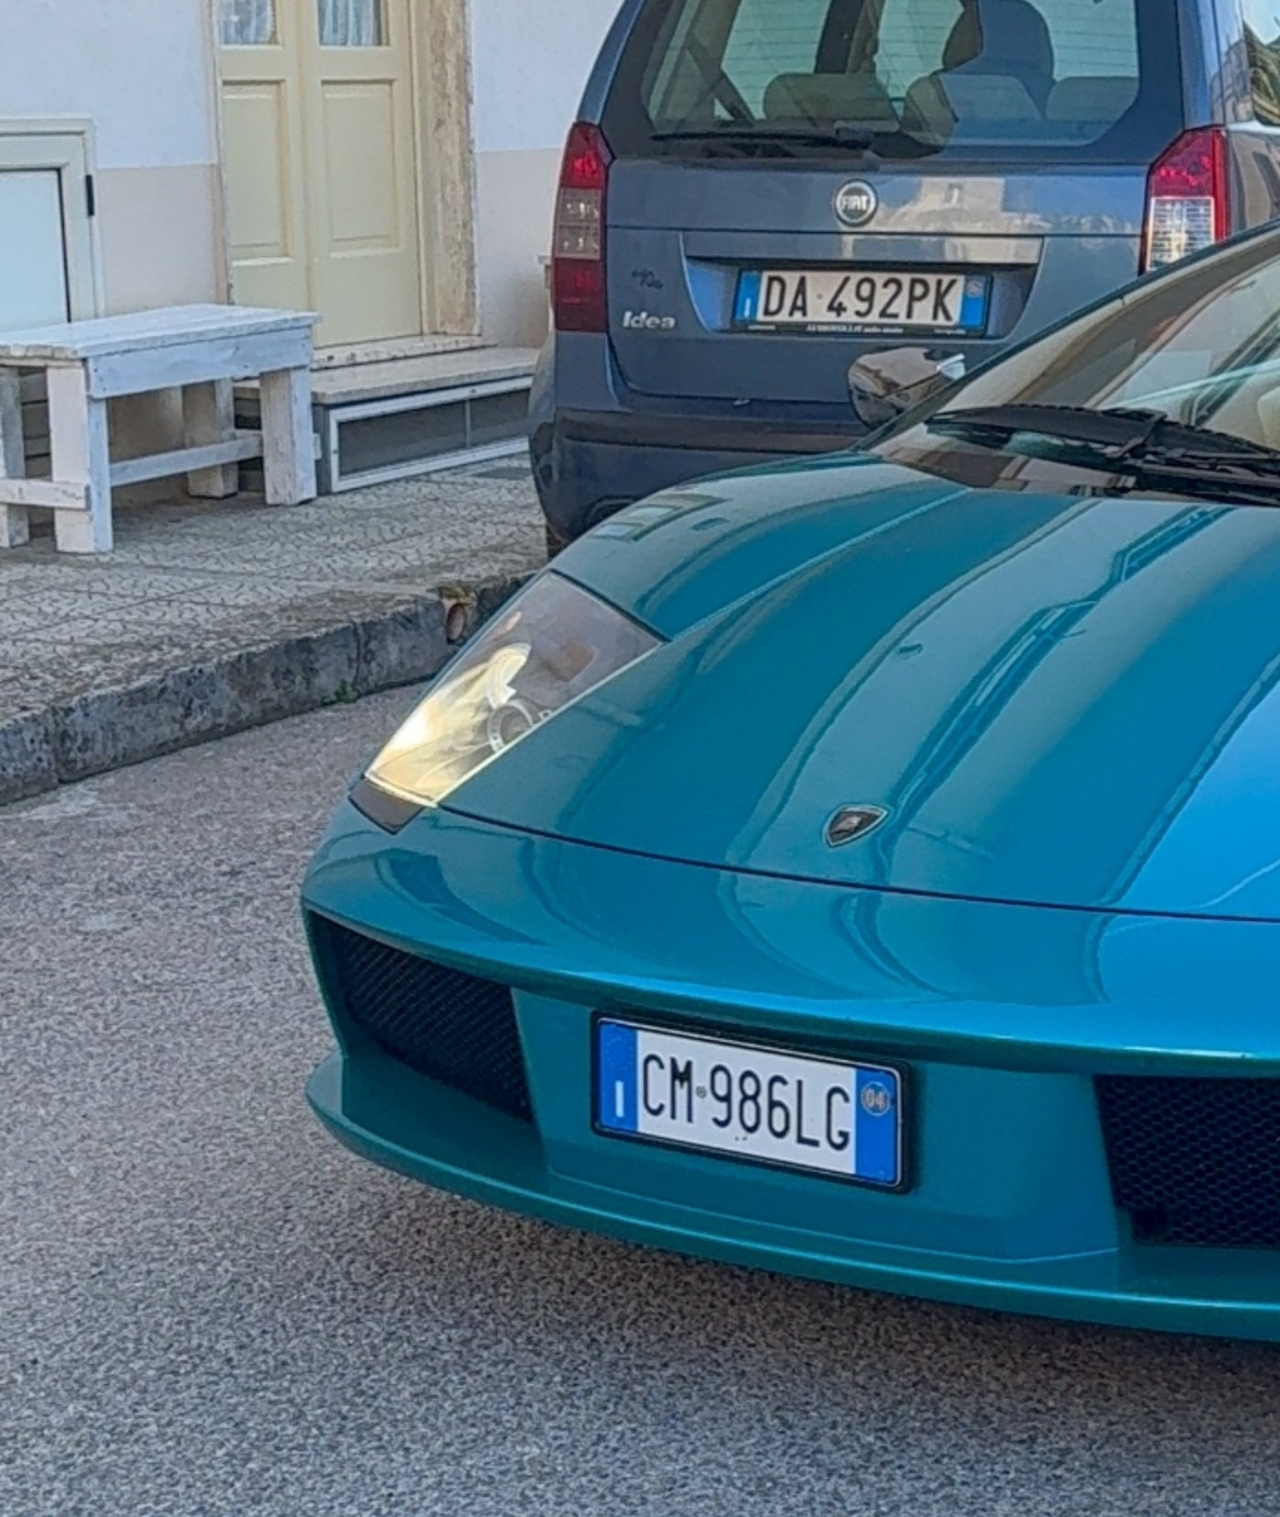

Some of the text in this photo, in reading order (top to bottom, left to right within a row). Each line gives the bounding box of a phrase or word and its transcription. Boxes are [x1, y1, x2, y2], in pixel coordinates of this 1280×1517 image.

[842, 194, 868, 211] FIAT
[762, 275, 808, 318] DA
[826, 275, 958, 322] 492PK
[622, 310, 676, 329] Idea
[642, 1053, 694, 1123] CM
[709, 1063, 851, 1151] 986LG
